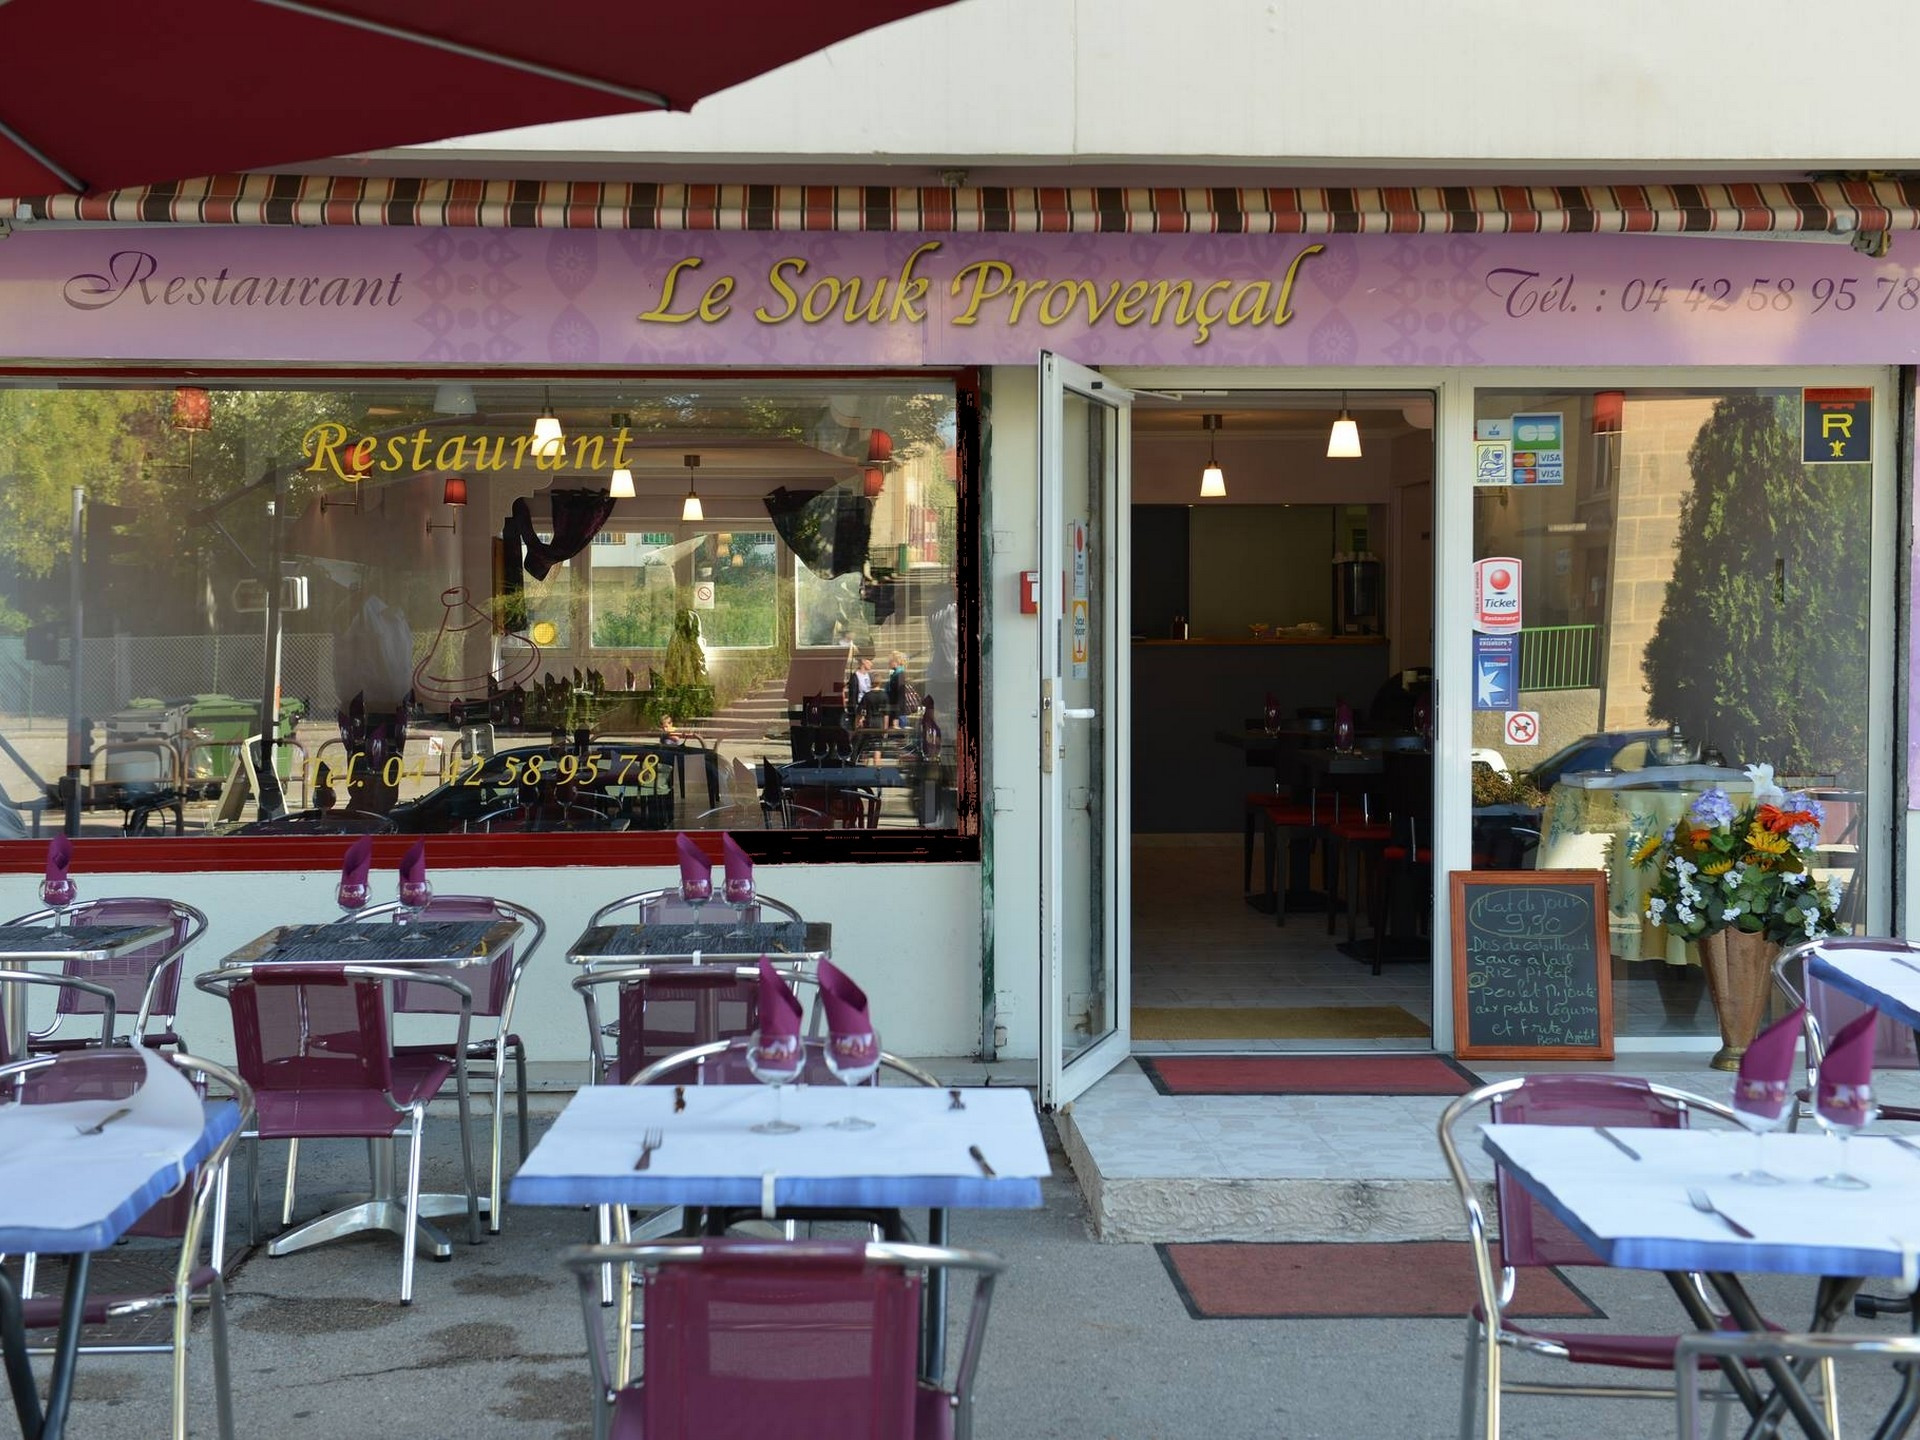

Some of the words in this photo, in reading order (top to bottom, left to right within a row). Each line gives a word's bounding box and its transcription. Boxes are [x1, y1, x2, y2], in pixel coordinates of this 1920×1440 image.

[63, 250, 403, 311] Restaurant
[637, 256, 735, 325] Le
[754, 241, 942, 325] Souk
[950, 243, 1325, 345] Provençal
[1486, 267, 1577, 318] Tél.
[1621, 277, 1669, 313] 04
[1683, 277, 1732, 313] 42
[1745, 277, 1796, 313] 58
[1810, 277, 1859, 313] 95
[1875, 277, 1920, 313] 78
[302, 422, 634, 482] Restaurant
[1541, 452, 1561, 462] VISA
[1541, 468, 1561, 479] VISA
[1484, 598, 1517, 608] Ticket
[383, 756, 426, 788] 04
[441, 754, 486, 787] 42
[497, 756, 543, 787] 58
[556, 753, 603, 787] 95
[617, 753, 661, 787] 78
